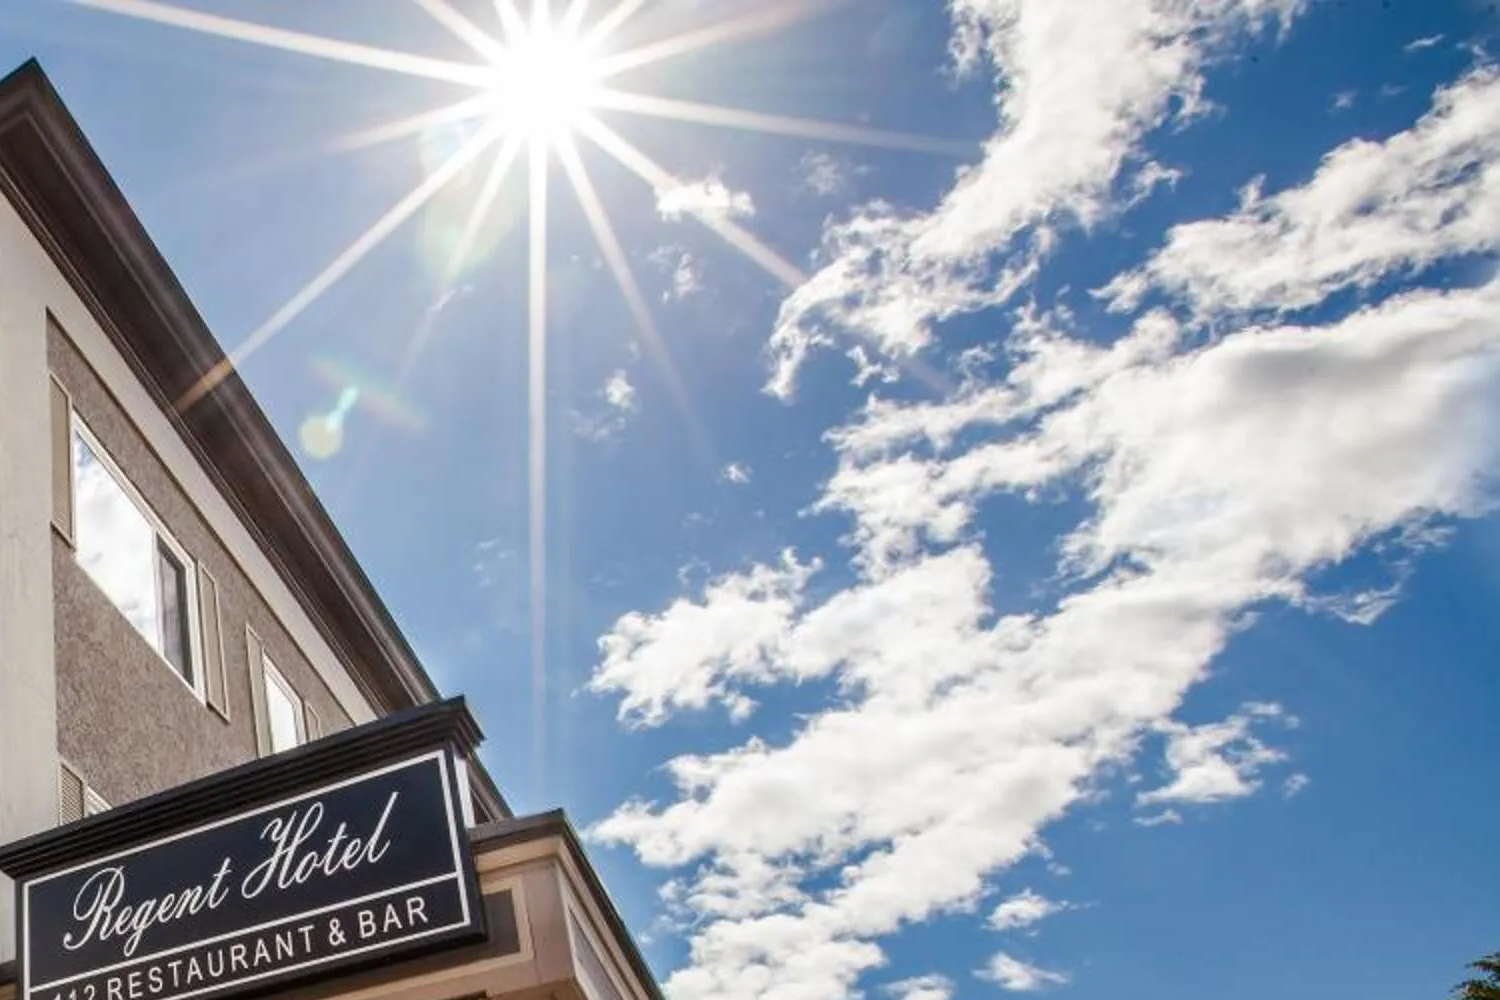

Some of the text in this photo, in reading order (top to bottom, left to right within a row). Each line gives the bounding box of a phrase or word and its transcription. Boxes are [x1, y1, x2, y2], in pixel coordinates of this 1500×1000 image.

[64, 791, 399, 957] Regent Hotel
[328, 917, 346, 947] &
[358, 896, 428, 940] BAR
